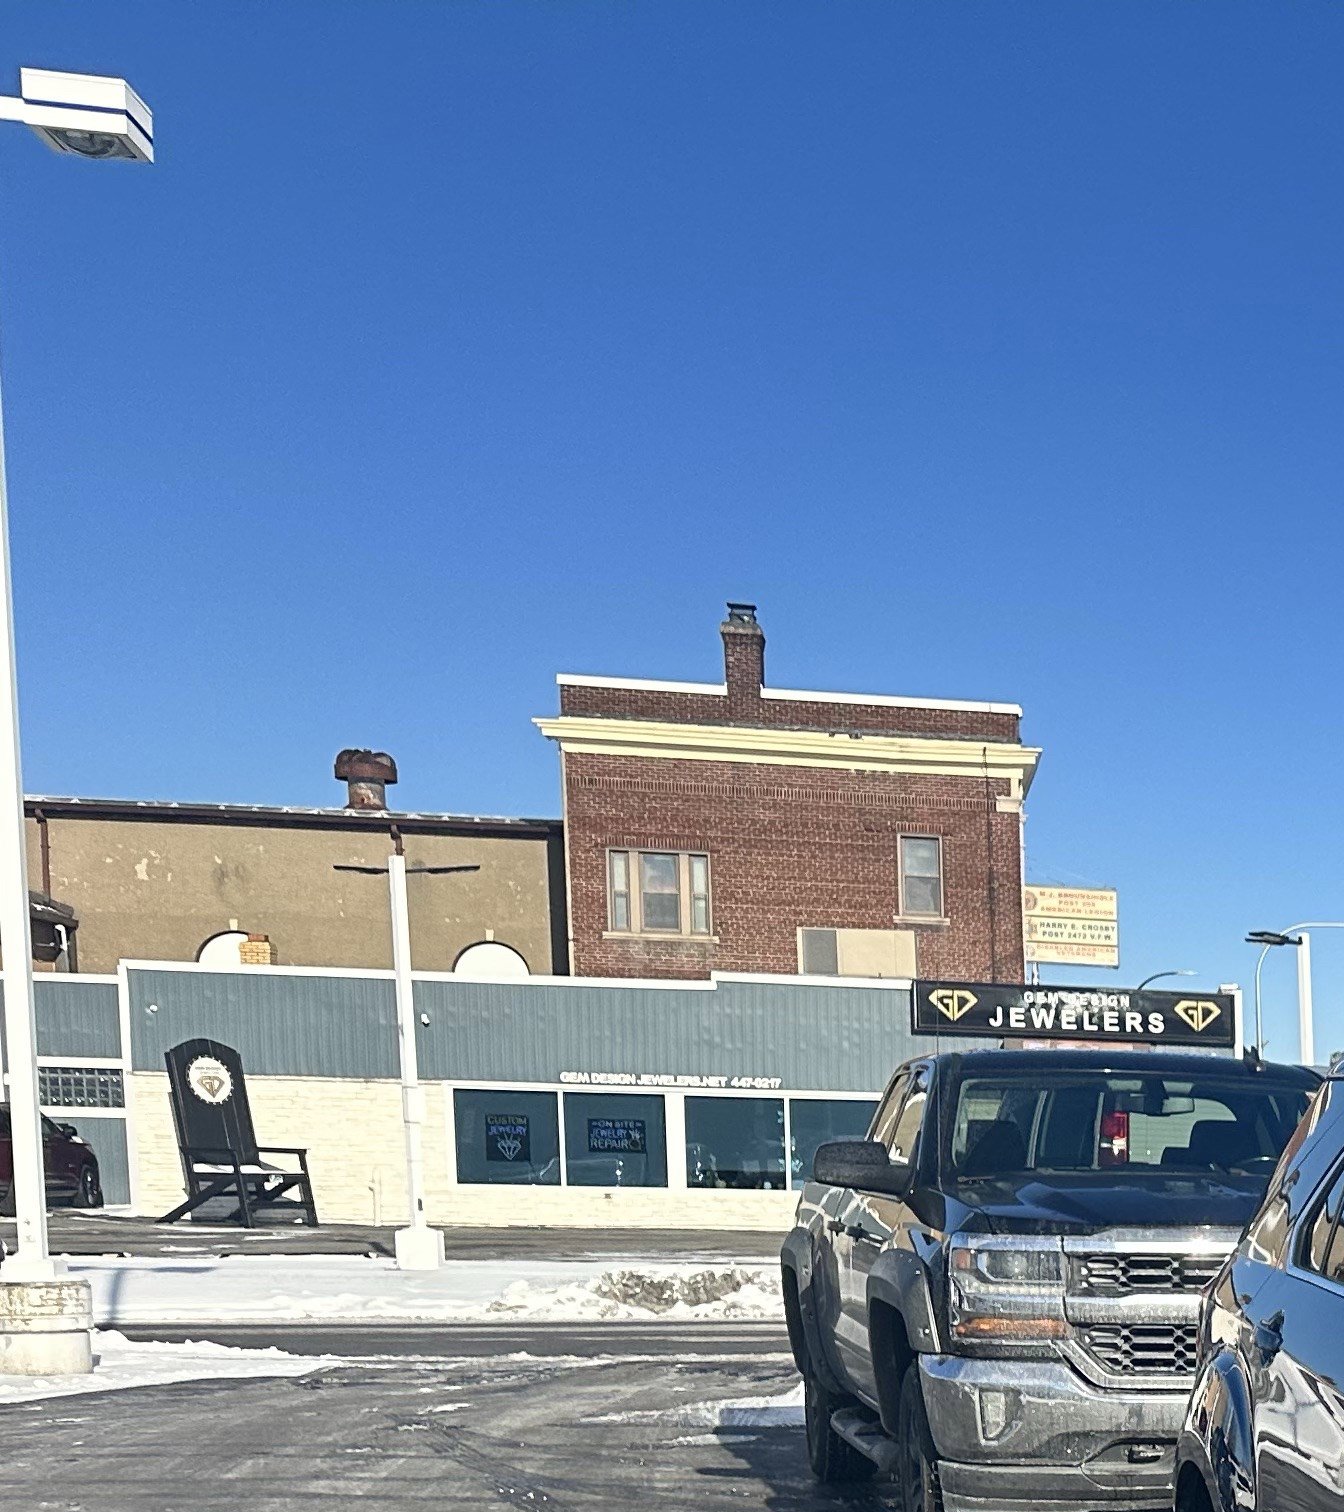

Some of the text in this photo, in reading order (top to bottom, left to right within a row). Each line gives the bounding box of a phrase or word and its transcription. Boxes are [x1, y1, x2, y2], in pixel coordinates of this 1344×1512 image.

[1039, 921, 1068, 930] HARRY
[1082, 924, 1116, 933] CROSBY
[1042, 930, 1064, 938] POST
[1023, 991, 1130, 1008] GEM DESIGN
[989, 1006, 1165, 1034] JEWELERS
[560, 1071, 590, 1084] GEM
[590, 1138, 629, 1150] REPAIR
